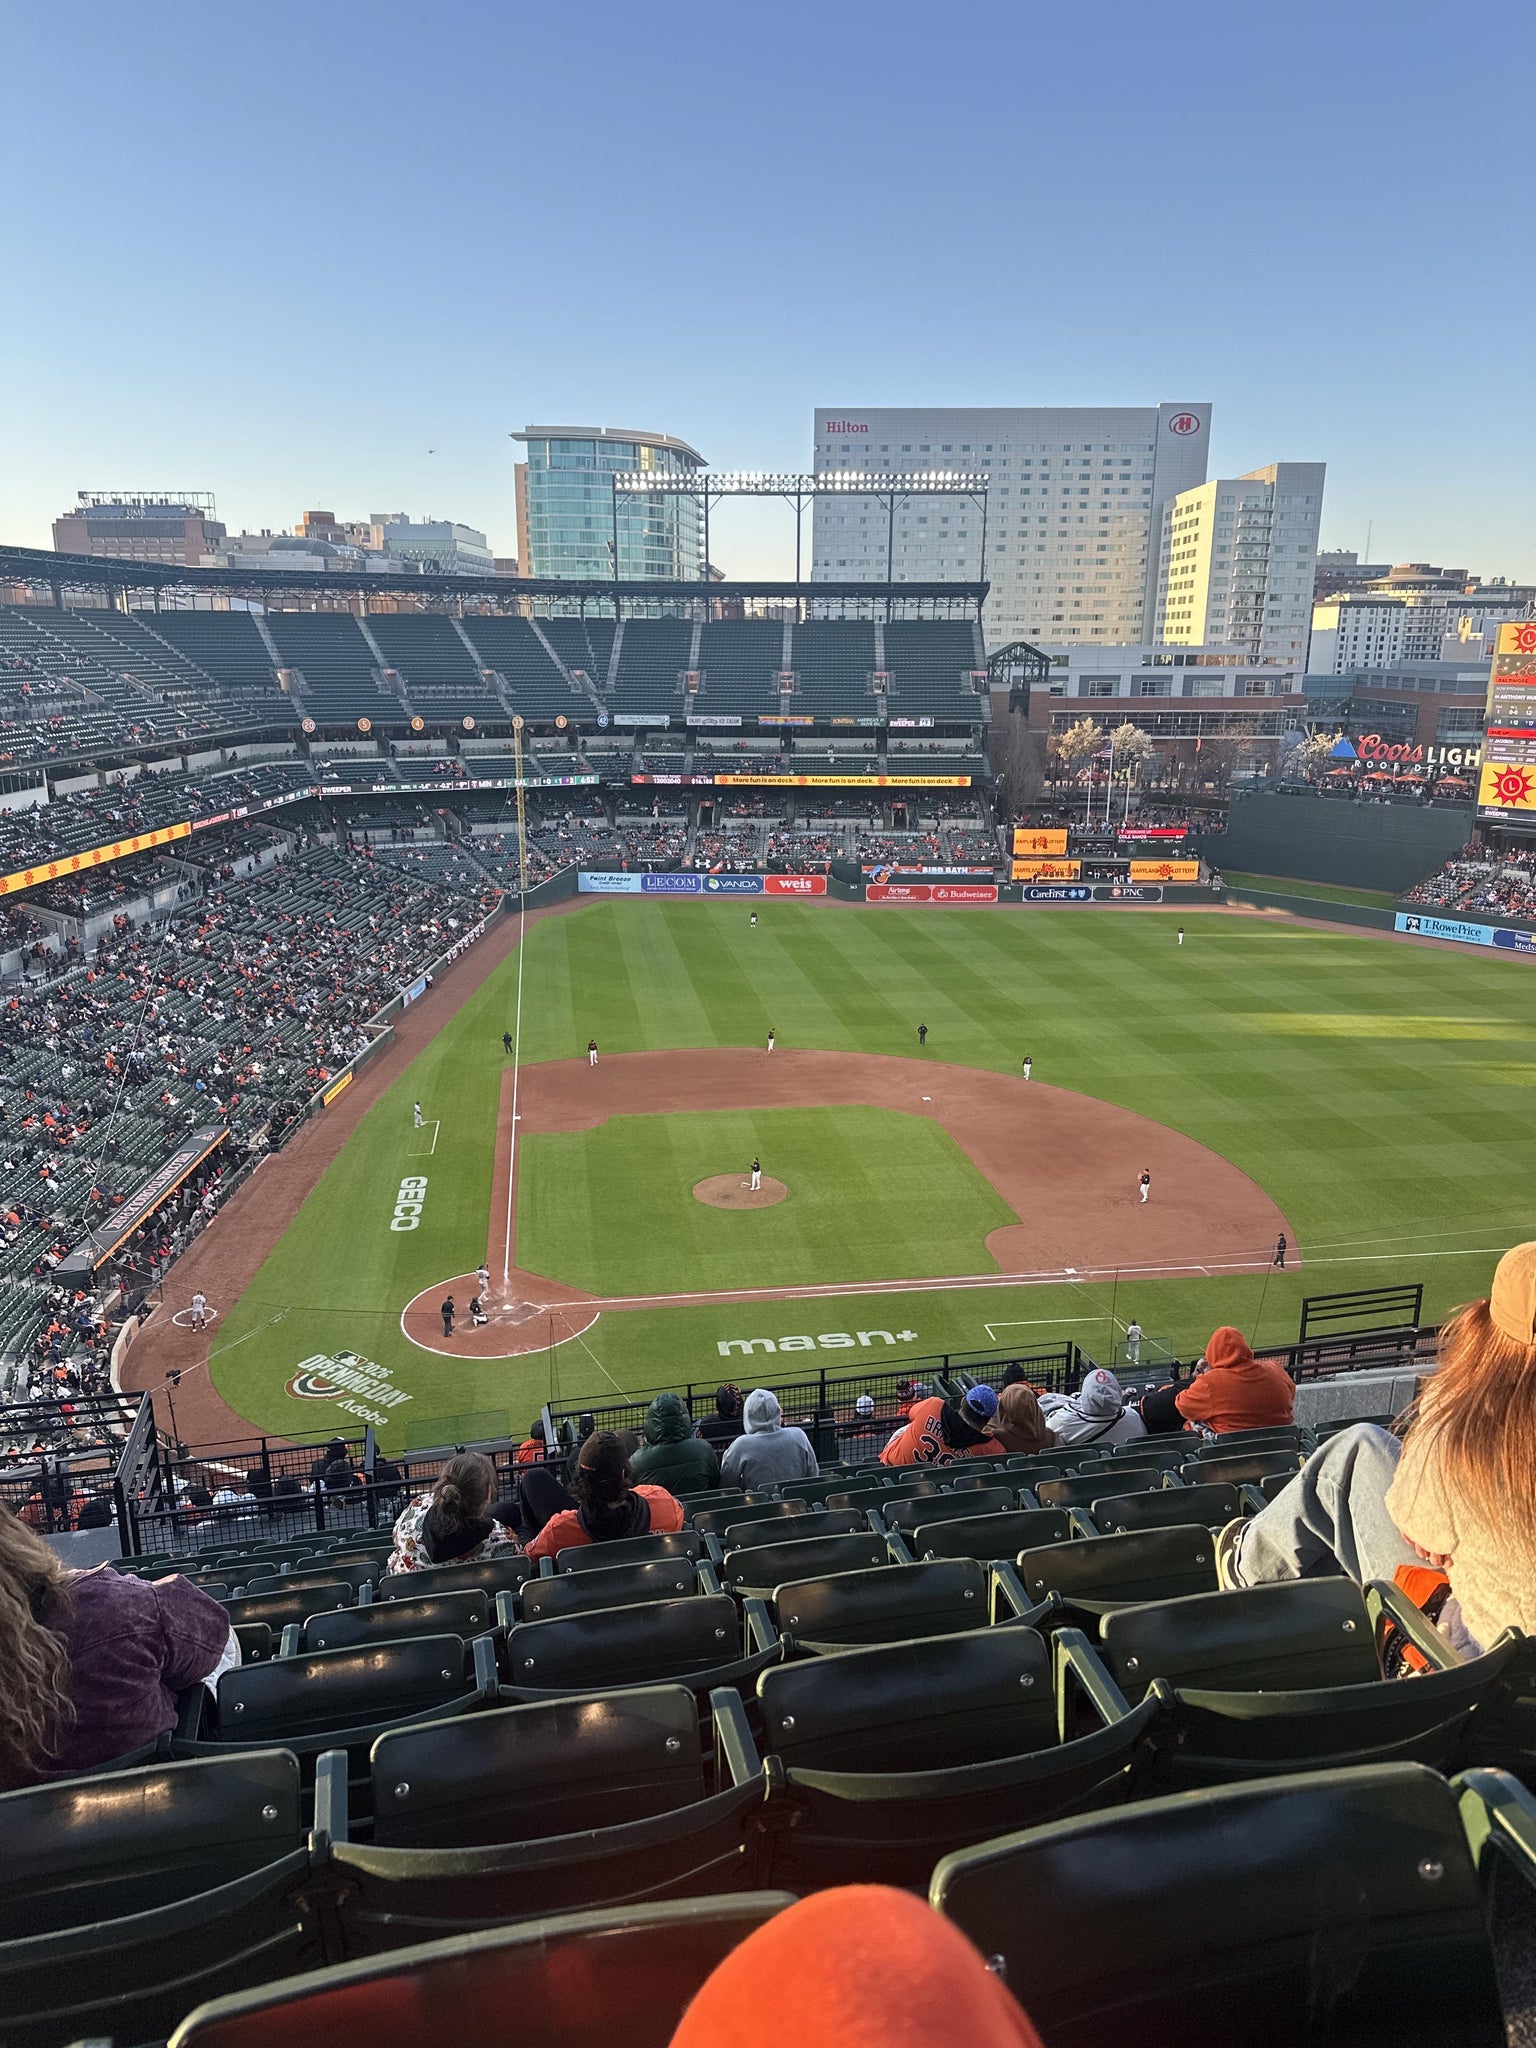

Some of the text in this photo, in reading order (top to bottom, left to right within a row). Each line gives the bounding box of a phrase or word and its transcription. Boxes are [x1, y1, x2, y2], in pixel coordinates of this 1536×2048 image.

[826, 420, 869, 433] Hilton
[126, 508, 146, 517] UMB
[303, 720, 314, 729] 20
[1357, 734, 1480, 767] Coors LIGH
[1354, 759, 1461, 775] ROOF DECK
[478, 779, 492, 788] MIN
[922, 866, 944, 874] BIRD
[945, 866, 970, 874] BATH
[646, 877, 696, 888] LECOM
[720, 879, 759, 888] VANDA
[779, 877, 812, 889] weis
[950, 890, 993, 898] Budweiser
[1030, 888, 1068, 899] CareFirst
[1123, 888, 1144, 897] PNC
[1514, 941, 1536, 951] MedS
[390, 1176, 428, 1232] GEICO
[357, 1361, 393, 1379] 2026
[336, 1399, 389, 1427] Adobe
